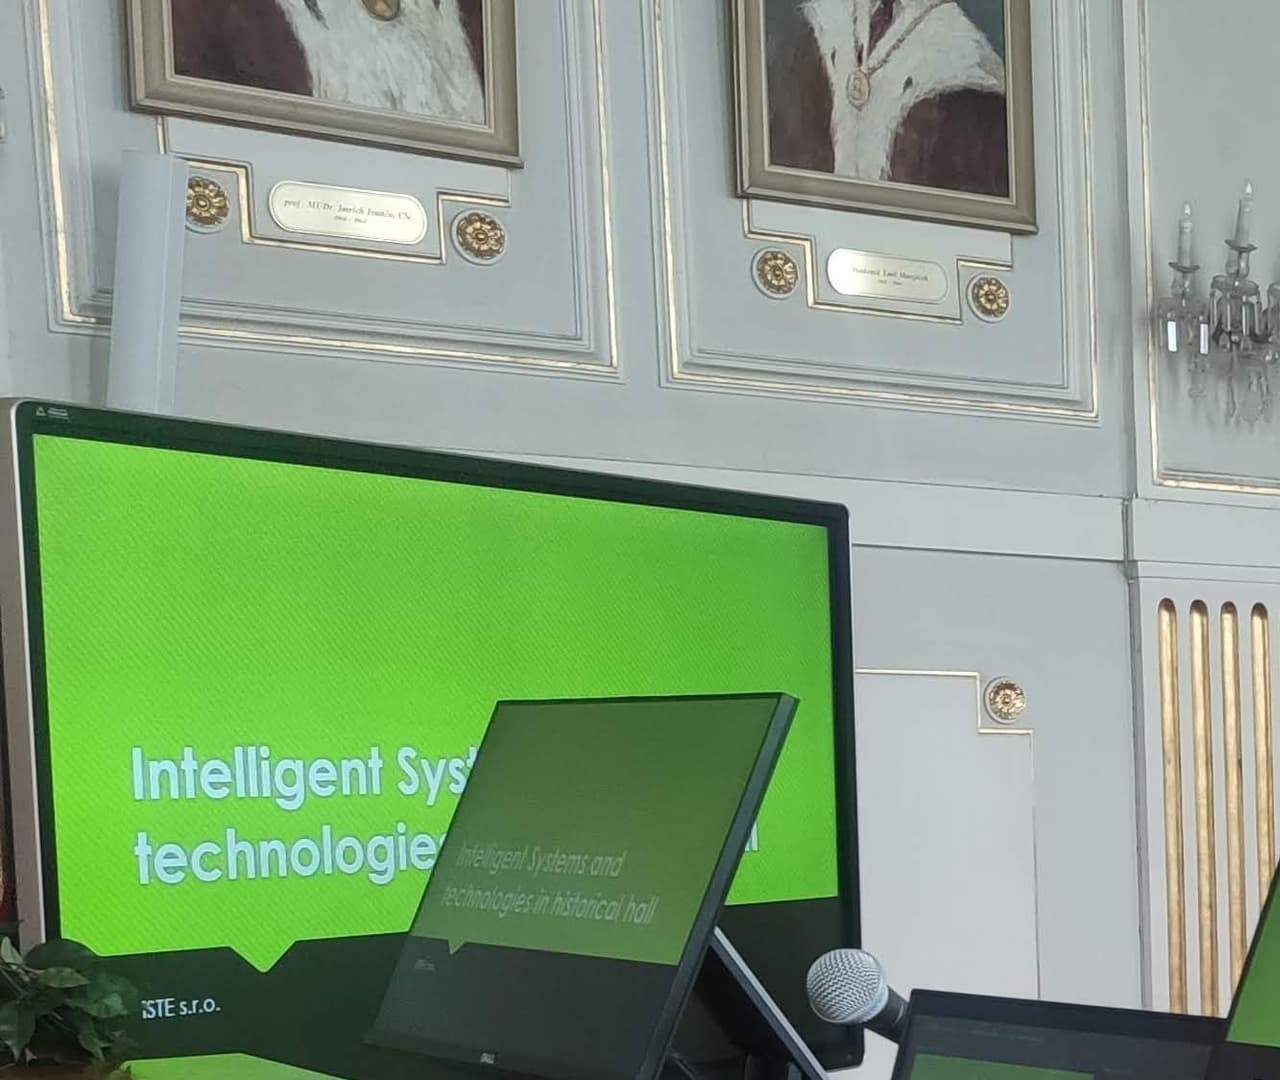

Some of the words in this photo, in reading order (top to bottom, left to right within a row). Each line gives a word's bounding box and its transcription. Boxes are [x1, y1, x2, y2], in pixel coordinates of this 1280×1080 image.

[131, 745, 383, 811] Intelligent
[133, 821, 447, 885] technologie
[527, 846, 589, 879] Systems
[590, 849, 628, 877] and
[622, 894, 660, 925] hall
[179, 998, 221, 1016] s.r.o.
